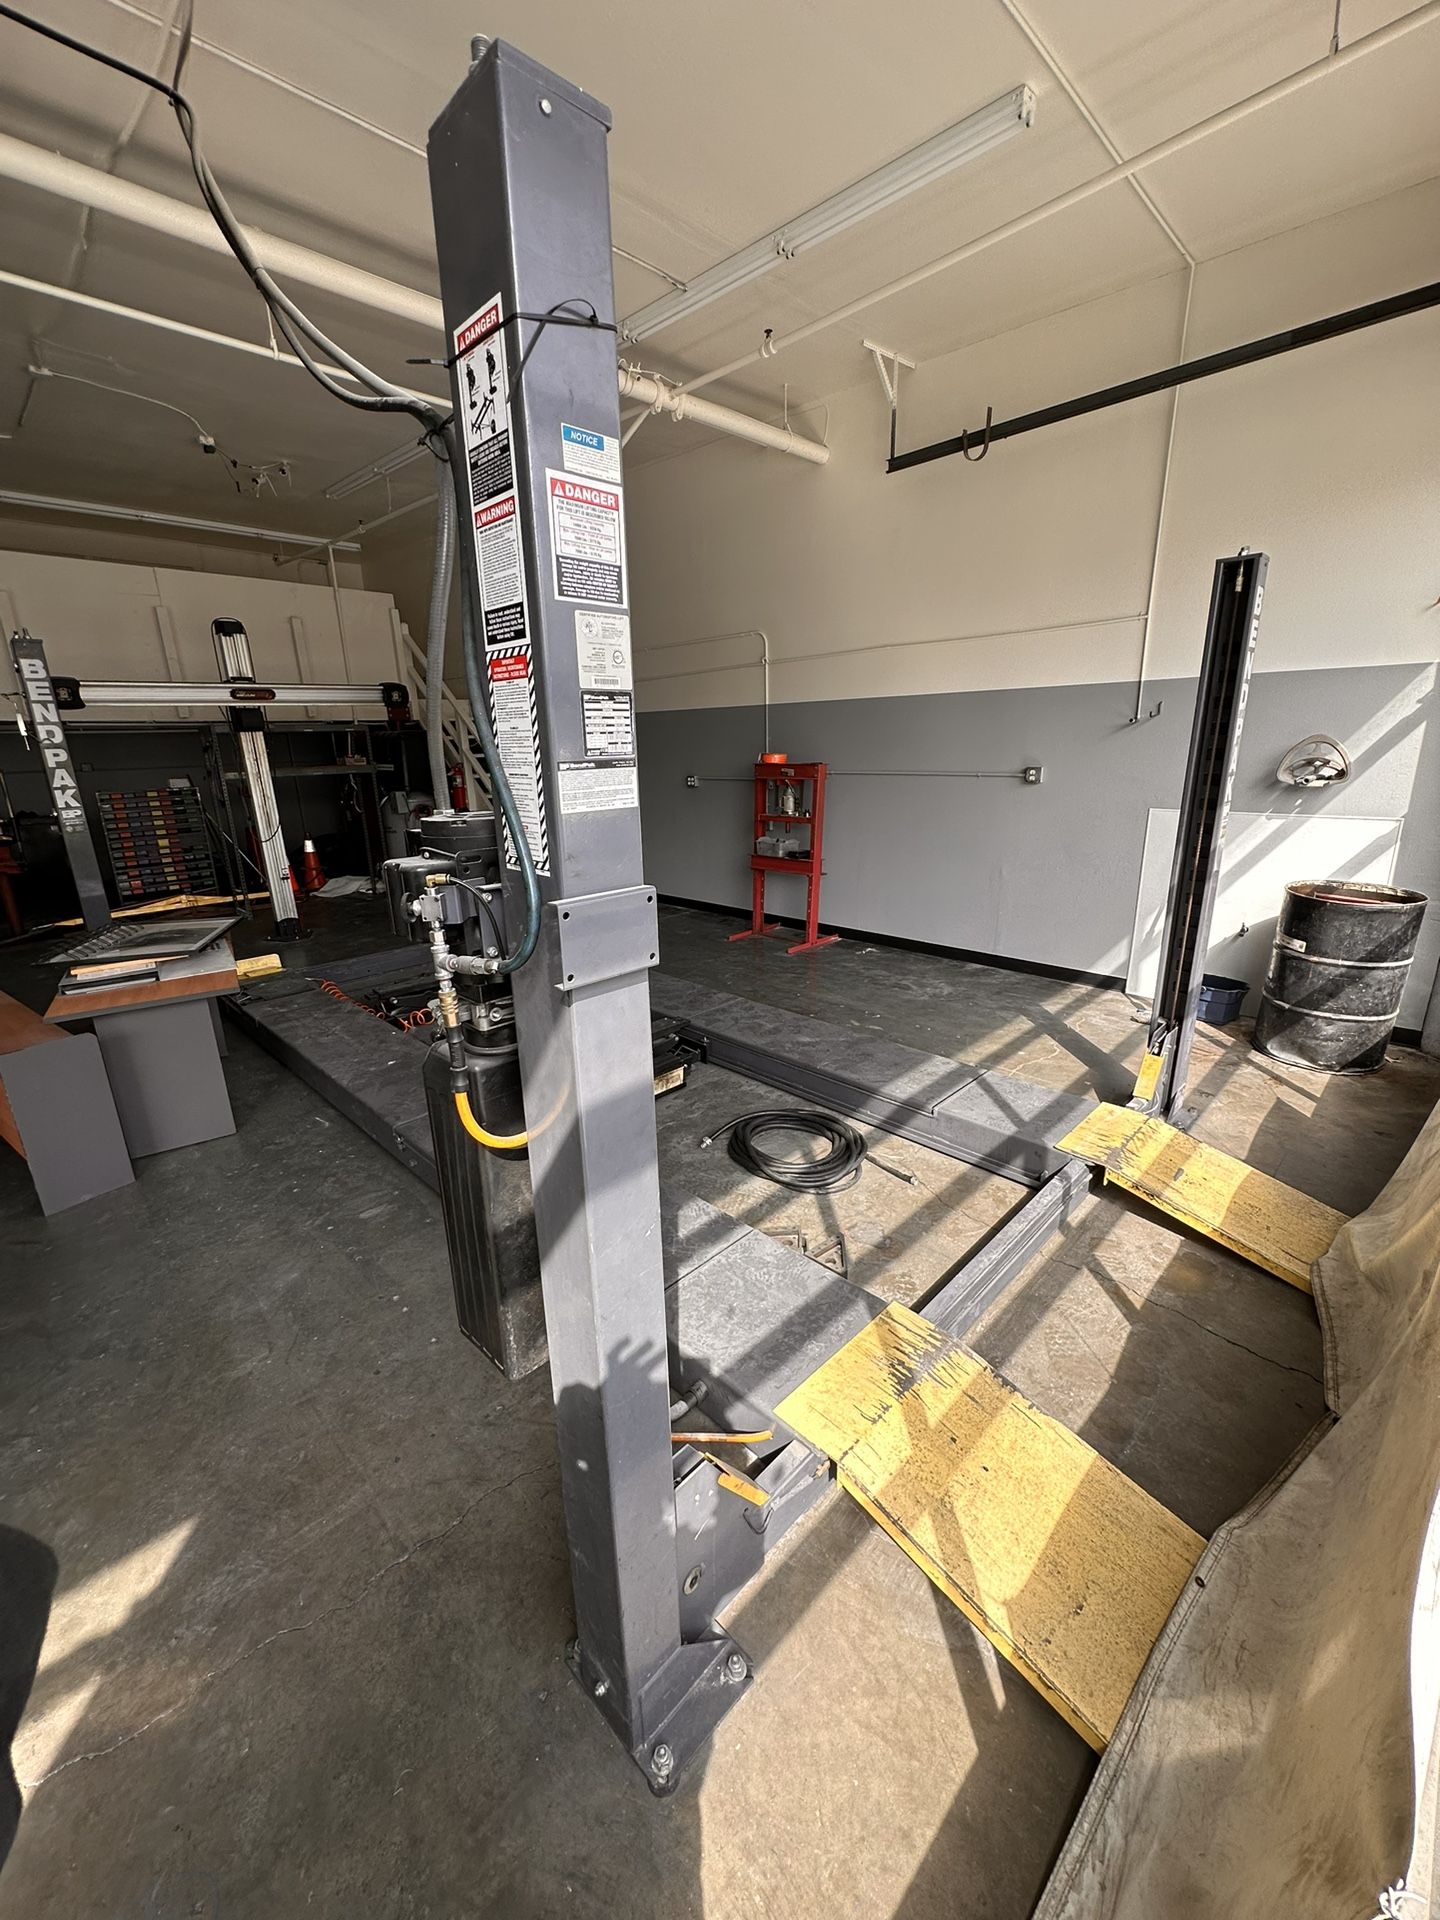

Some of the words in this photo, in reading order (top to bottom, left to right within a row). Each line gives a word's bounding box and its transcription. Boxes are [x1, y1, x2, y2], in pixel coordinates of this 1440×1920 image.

[465, 310, 497, 345] DANGER
[571, 430, 598, 446] NOTICE
[565, 483, 616, 507] DANGER
[480, 499, 514, 524] WARNING
[20, 658, 81, 808] BENDPAK
